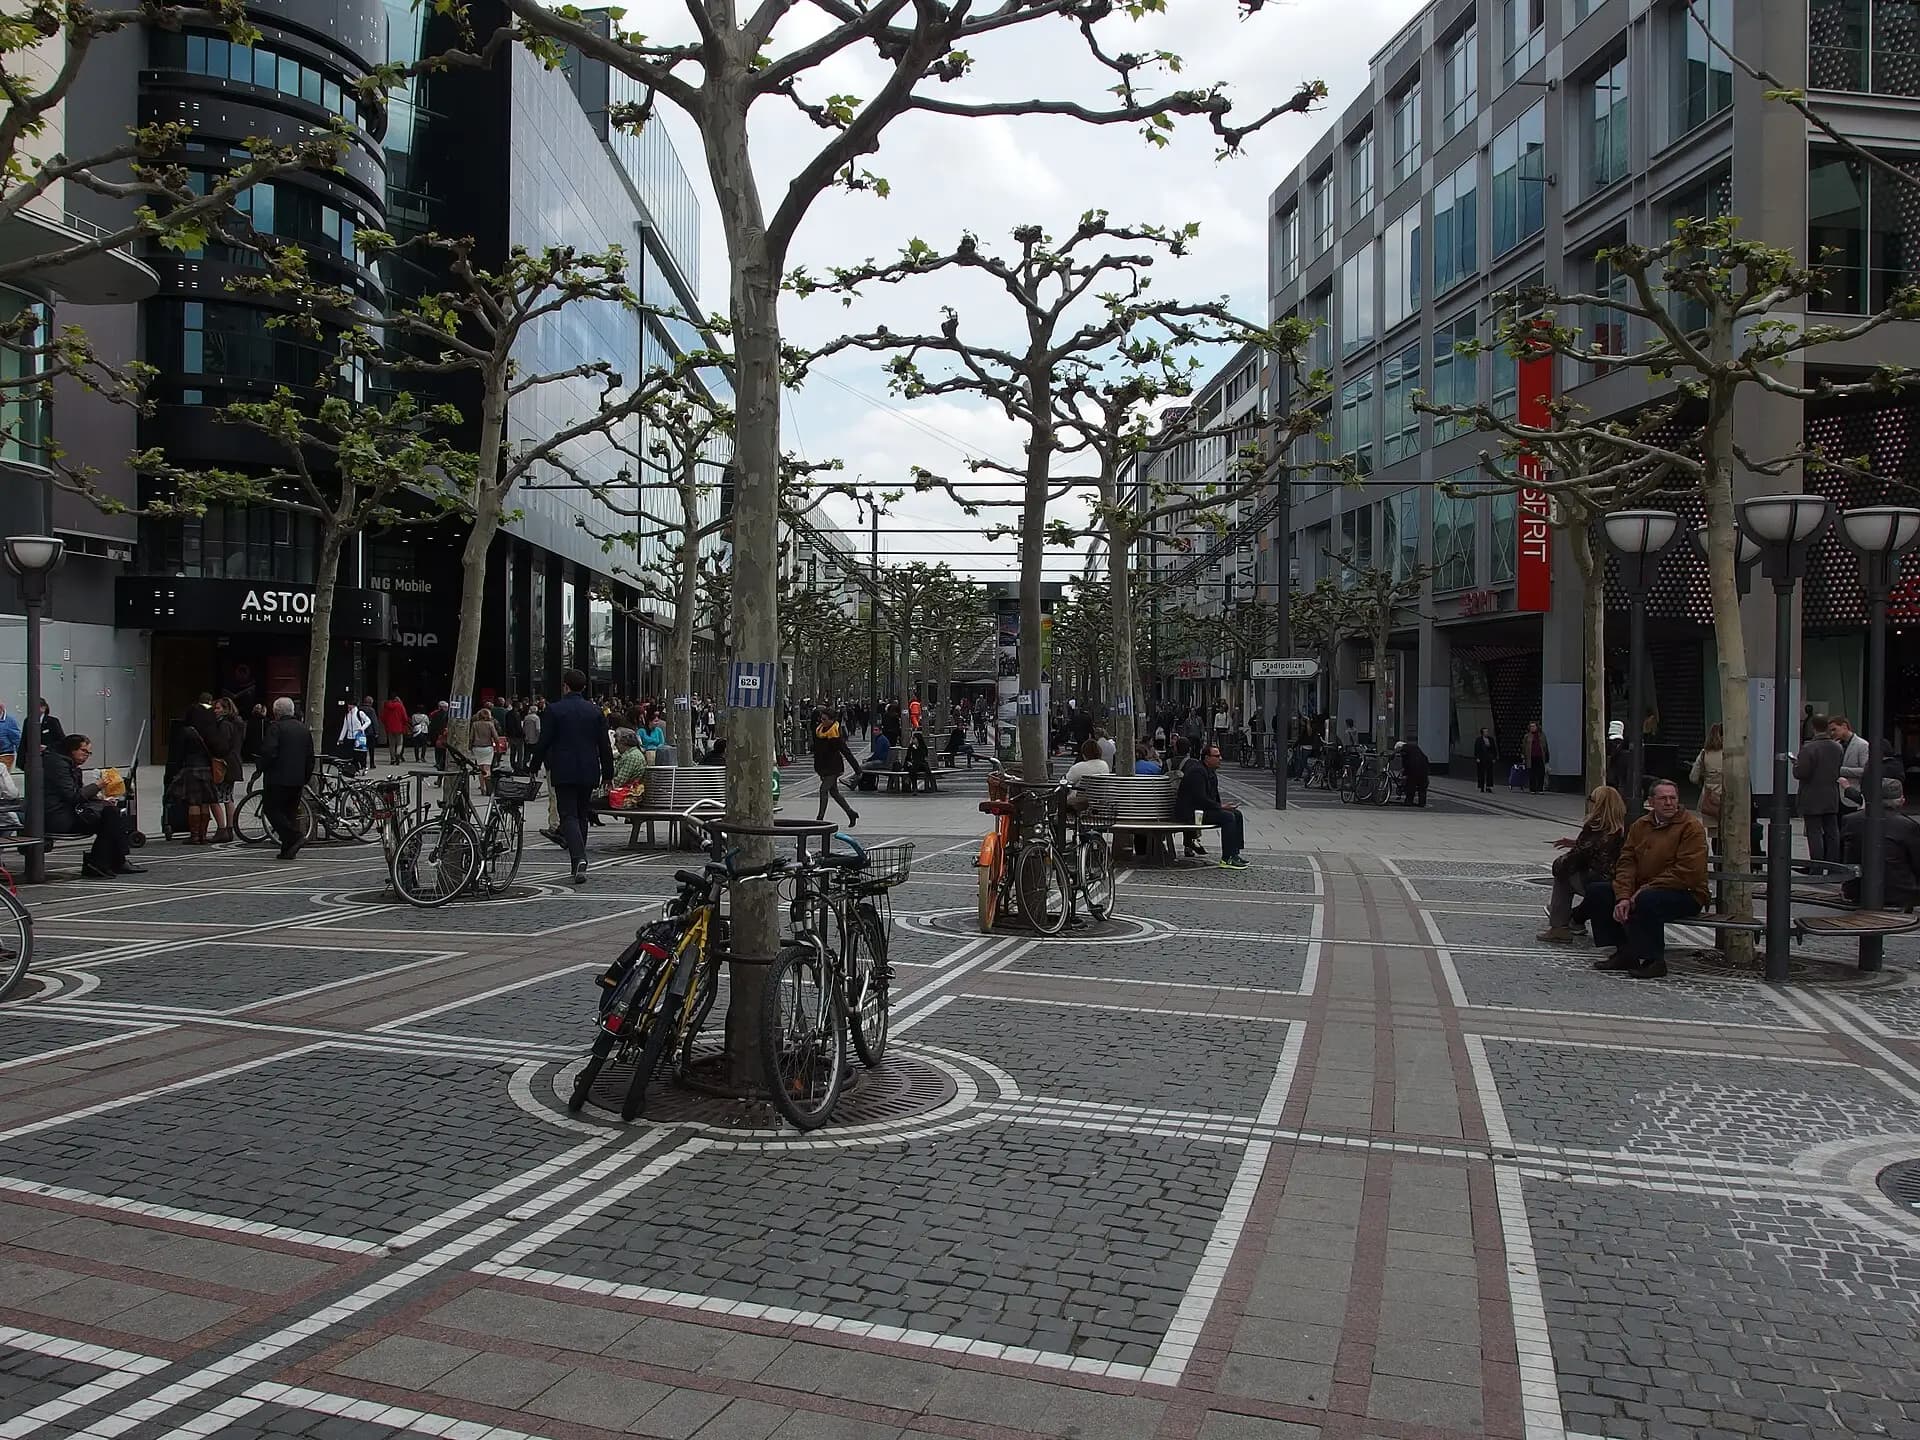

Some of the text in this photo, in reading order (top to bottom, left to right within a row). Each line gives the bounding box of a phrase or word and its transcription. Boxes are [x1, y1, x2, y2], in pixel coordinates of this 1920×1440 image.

[1237, 448, 1254, 590] SALADR
[1523, 464, 1546, 563] ESPRIT
[395, 578, 432, 593] Mobile
[241, 613, 315, 624] FILM LOUN
[1262, 662, 1305, 670] Stadtpolizei
[740, 678, 758, 687] 626
